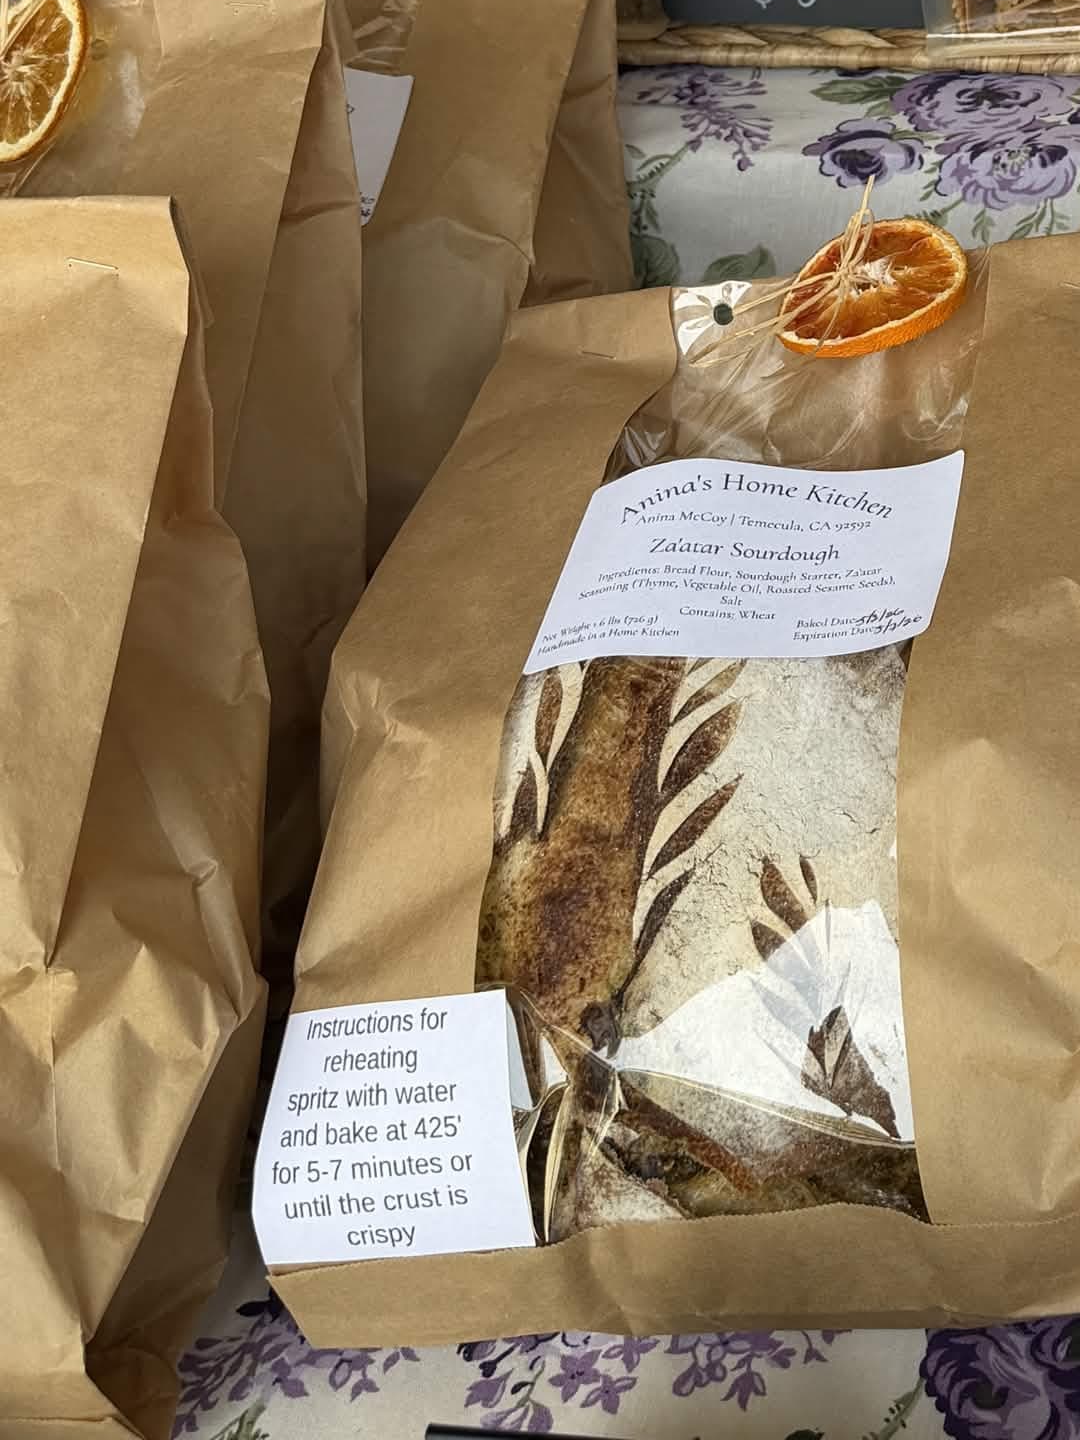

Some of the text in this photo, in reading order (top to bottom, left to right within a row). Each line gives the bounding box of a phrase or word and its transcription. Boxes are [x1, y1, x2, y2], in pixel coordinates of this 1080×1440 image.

[621, 473, 893, 524] Anina's Home Kitchen
[636, 511, 871, 532] Anina McCoy Temecula, CA 92592
[650, 538, 840, 565] Za'atar Sourdough
[599, 567, 660, 582] Ingredients:
[664, 565, 696, 575] Bread
[699, 566, 731, 578] Flour,
[736, 570, 797, 584] Sourdough
[801, 572, 841, 580] Starter,
[578, 582, 628, 600] Seasoning
[632, 579, 678, 590] (Thyme,
[683, 579, 736, 591] Vegetable
[741, 584, 762, 595] Oil,
[766, 585, 811, 594] Roasted
[815, 584, 855, 592] Sesame
[720, 596, 743, 606] Salt
[739, 610, 775, 620] Wheat
[797, 619, 827, 628] Baked
[537, 627, 679, 655] Handmade in Home Kitchen
[793, 630, 847, 642] Expiration
[307, 1008, 448, 1040] Instructions for
[324, 1046, 418, 1073] reheating
[288, 1083, 456, 1116] spritz with water
[280, 1115, 462, 1148] and bake at 425'
[272, 1154, 473, 1184] for 5-7 minutes or
[285, 1185, 468, 1219] until the crust is
[347, 1225, 415, 1247] crispy
